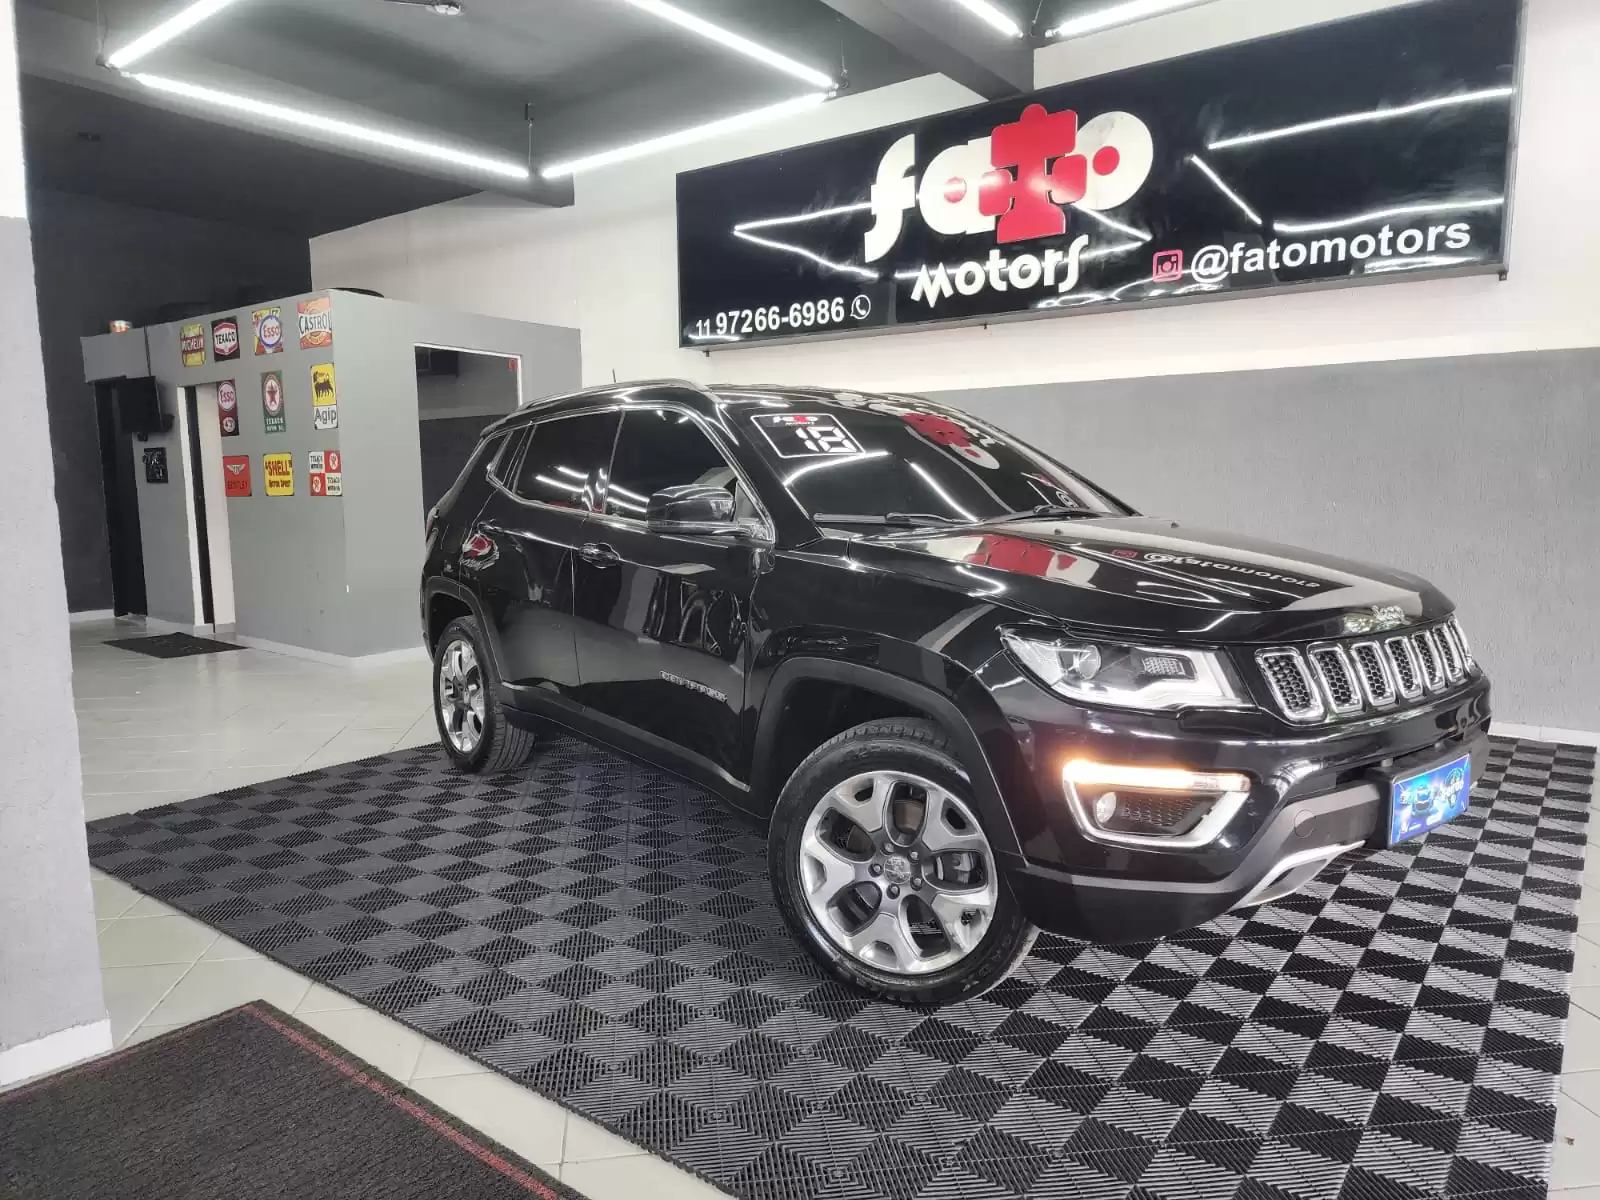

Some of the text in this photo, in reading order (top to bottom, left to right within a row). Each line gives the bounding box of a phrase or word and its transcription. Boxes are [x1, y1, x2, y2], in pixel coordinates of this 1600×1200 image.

[1190, 222, 1471, 283] @fatomotors
[298, 311, 332, 335] CASTROL
[696, 297, 845, 336] 11 97266-6986
[314, 407, 337, 425] Agip
